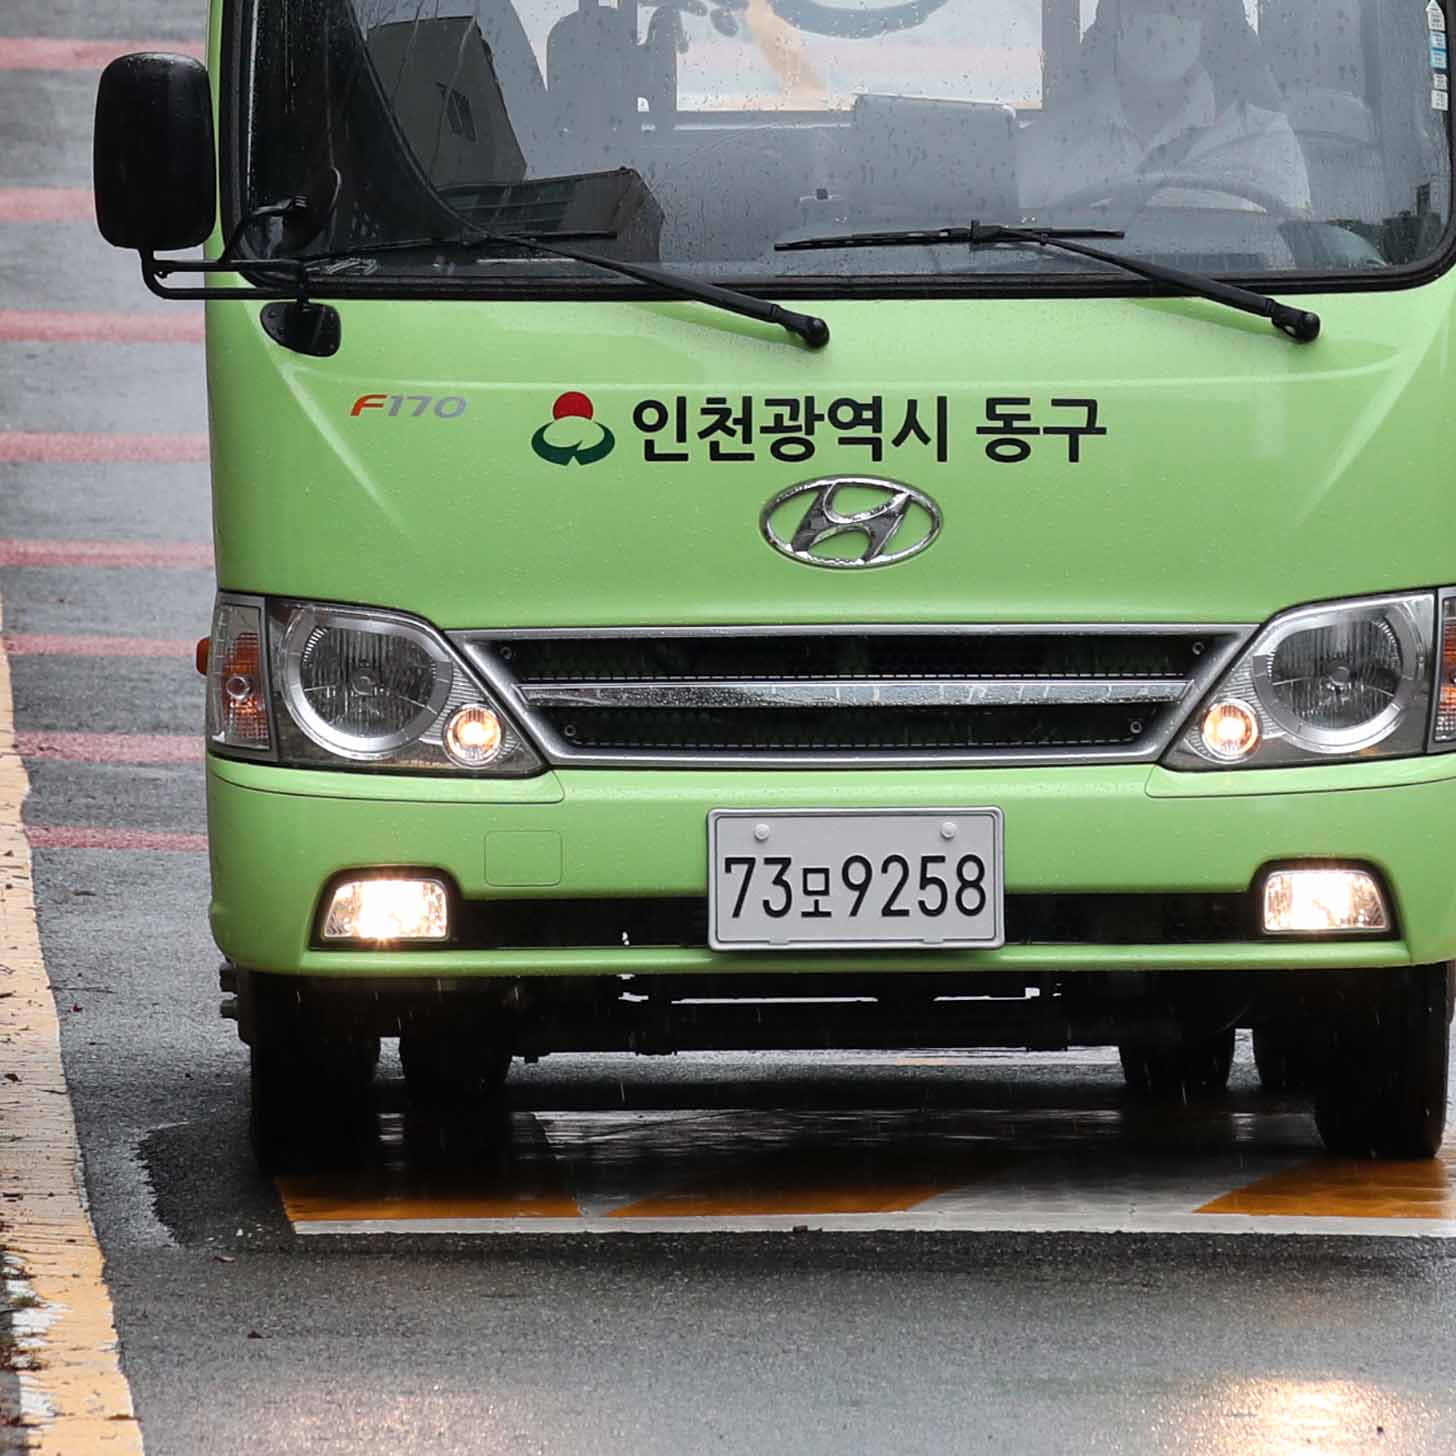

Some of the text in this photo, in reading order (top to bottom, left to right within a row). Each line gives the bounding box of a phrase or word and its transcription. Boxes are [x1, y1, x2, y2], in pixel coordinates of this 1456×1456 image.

[350, 393, 468, 419] F170
[632, 395, 1107, 463] 인천광역시 동구
[724, 854, 987, 919] 73모9258
